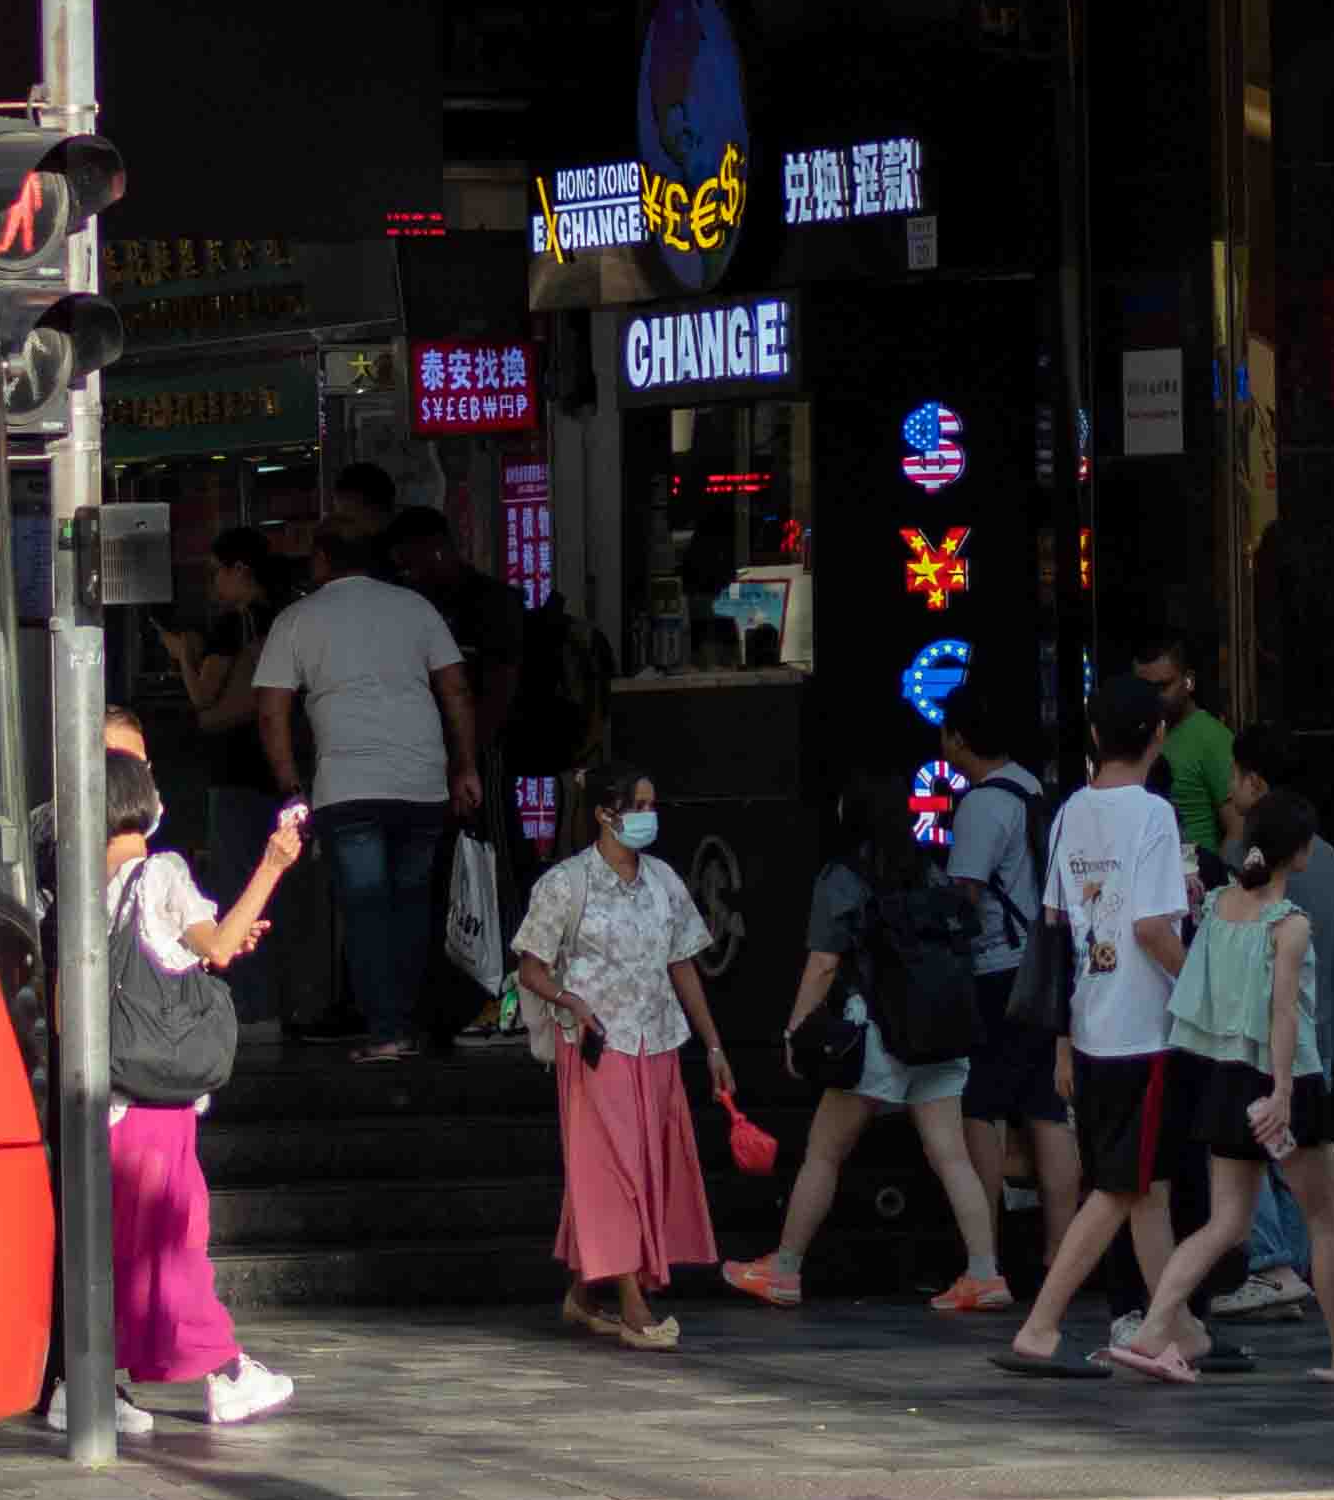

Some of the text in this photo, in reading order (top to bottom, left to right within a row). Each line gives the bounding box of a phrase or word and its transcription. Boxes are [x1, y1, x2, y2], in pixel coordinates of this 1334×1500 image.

[557, 162, 639, 200] HONG KONG
[533, 190, 645, 260] EXCHANGE
[627, 302, 785, 389] CHANGE
